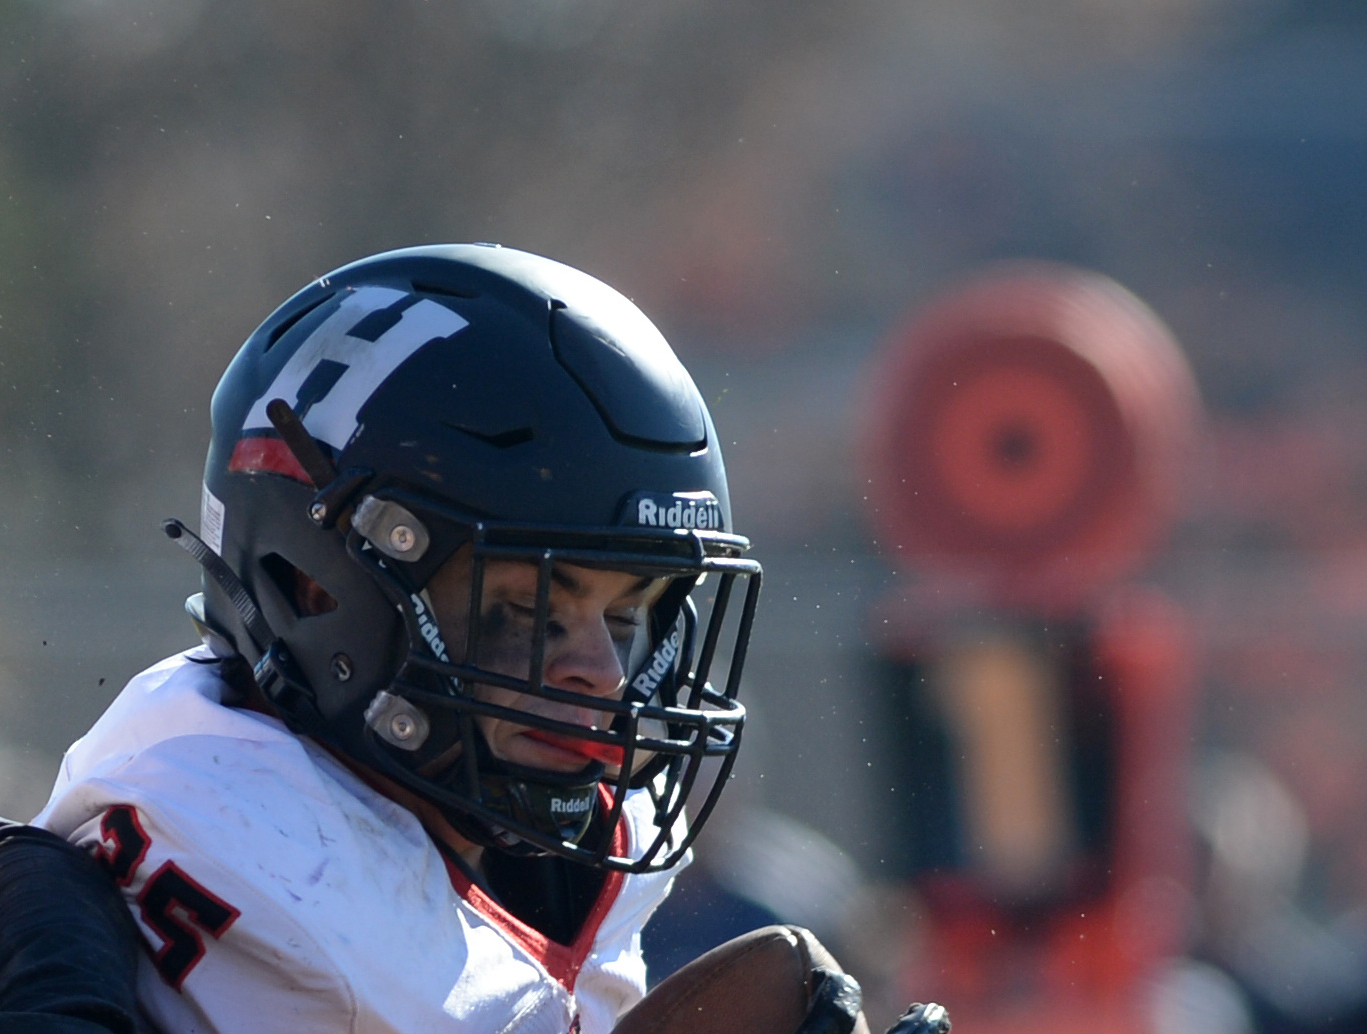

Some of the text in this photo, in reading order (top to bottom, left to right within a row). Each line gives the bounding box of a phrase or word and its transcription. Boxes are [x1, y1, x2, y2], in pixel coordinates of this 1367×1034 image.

[242, 286, 469, 451] H
[638, 498, 719, 529] Riddell
[632, 630, 680, 698] Ridde
